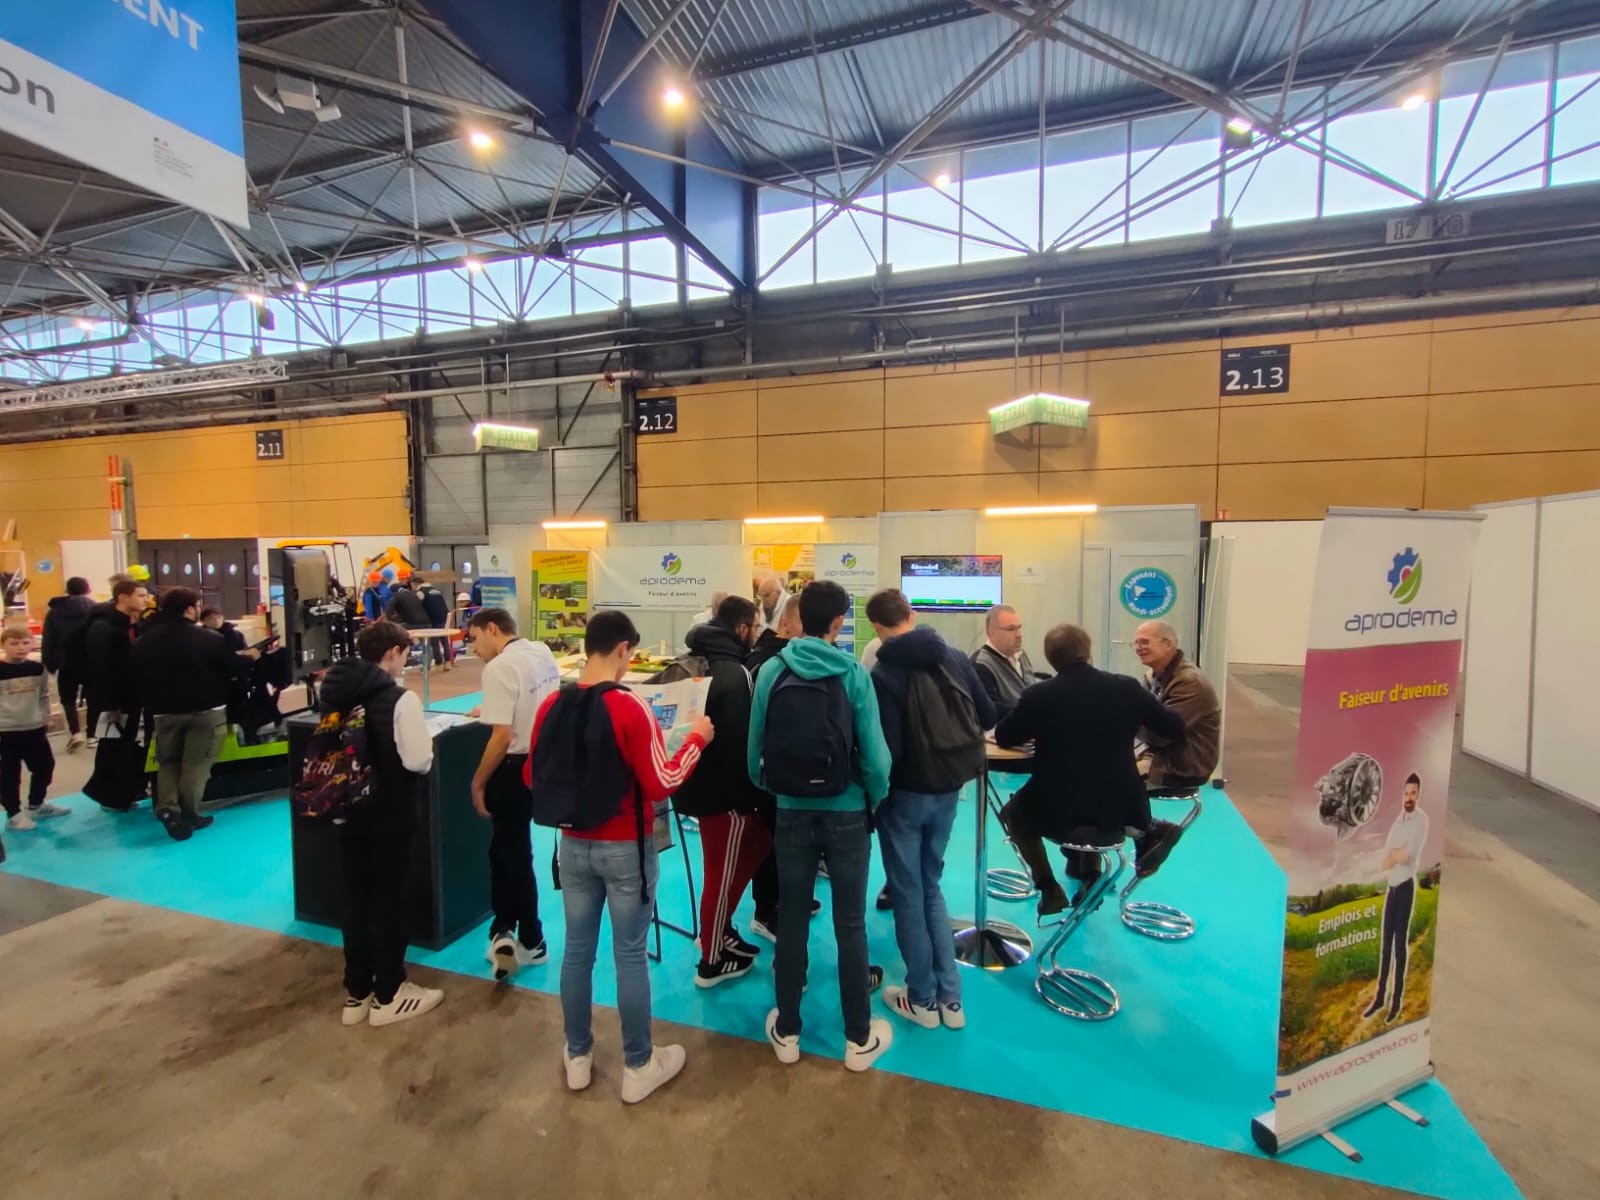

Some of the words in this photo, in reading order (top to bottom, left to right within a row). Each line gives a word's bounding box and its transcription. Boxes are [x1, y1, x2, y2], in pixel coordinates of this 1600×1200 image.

[112, 0, 204, 50] ENT
[1225, 366, 1284, 391] 2.13
[639, 413, 674, 431] 2.12
[258, 443, 282, 456] 2.11
[639, 576, 706, 586] aprodema
[1345, 608, 1457, 634] aprodema
[1339, 689, 1386, 709] Faiseur
[1389, 680, 1449, 702] d'avenirs
[1318, 907, 1362, 934] Emplois
[1364, 904, 1377, 918] et
[1315, 927, 1378, 958] formations
[1296, 1033, 1419, 1091] www.aprodema.org
